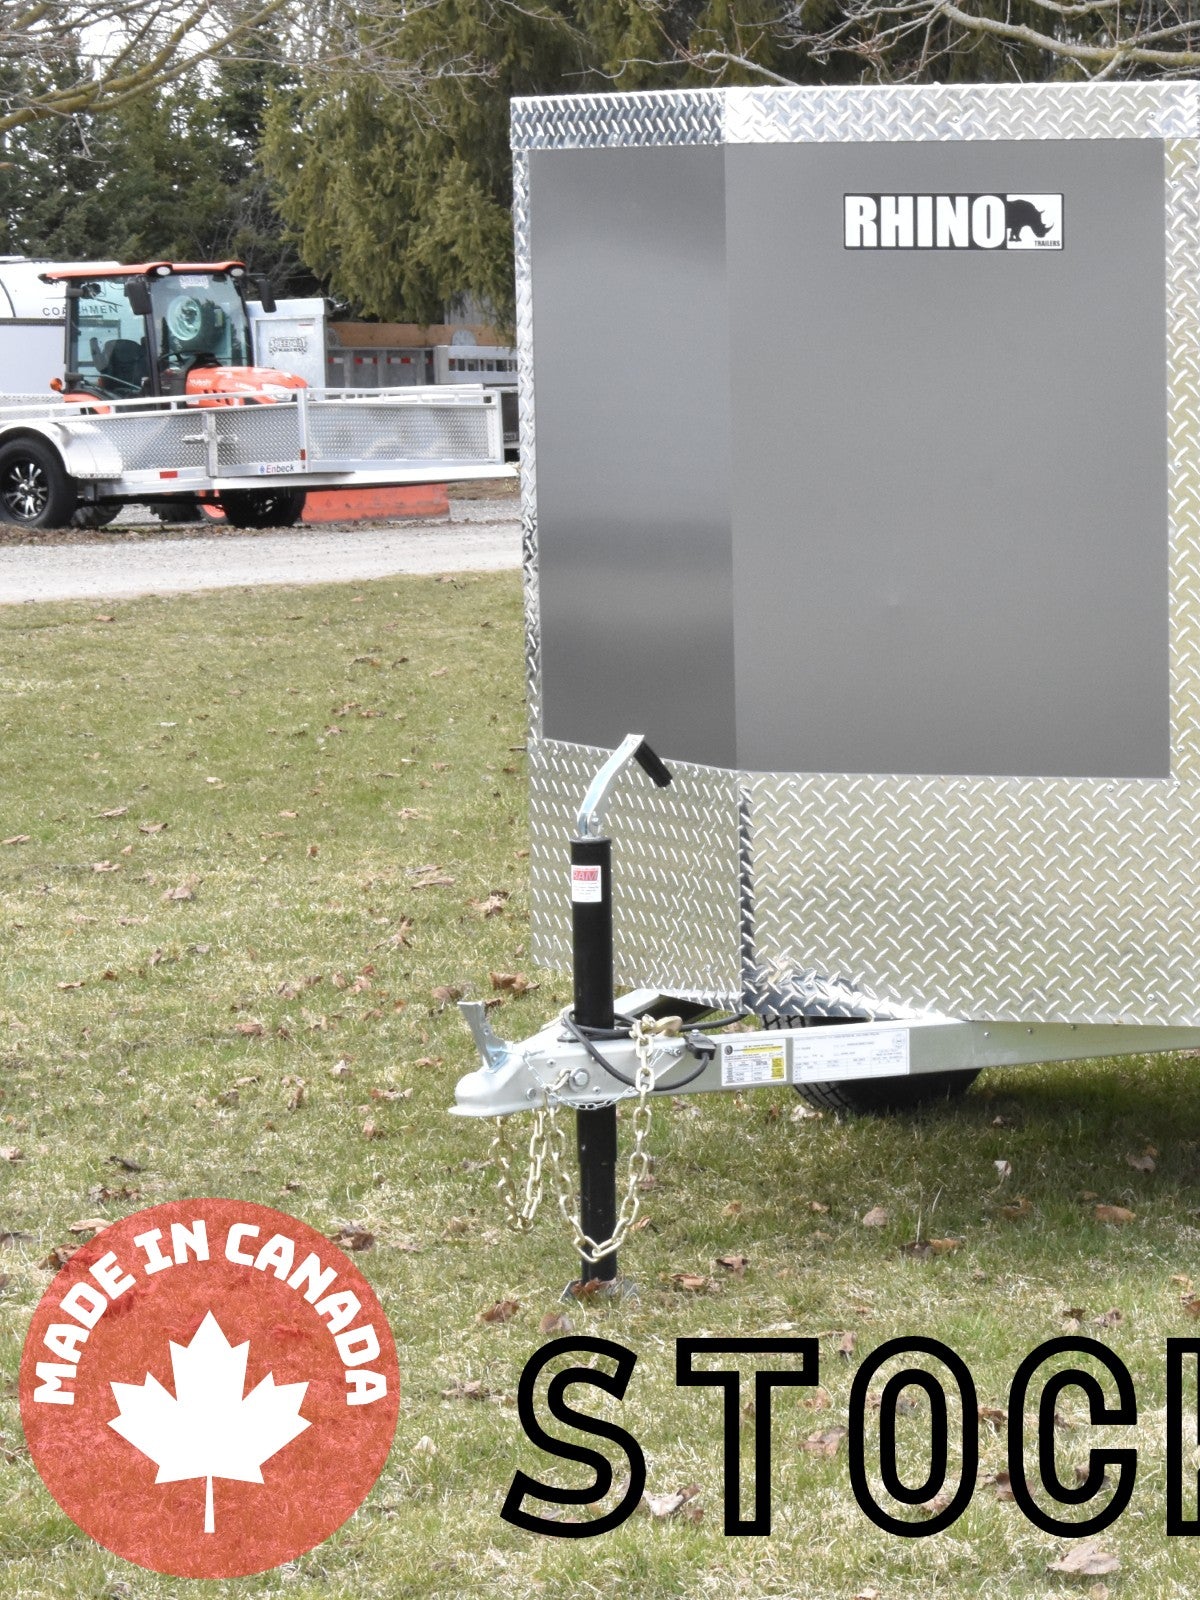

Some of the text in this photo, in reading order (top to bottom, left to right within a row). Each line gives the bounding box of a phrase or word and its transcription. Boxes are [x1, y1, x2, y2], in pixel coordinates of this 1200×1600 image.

[845, 195, 1006, 249] RHINO
[1034, 239, 1061, 248] TRAILERS
[42, 305, 119, 316] COAHMEN
[266, 464, 295, 473] Enbeck
